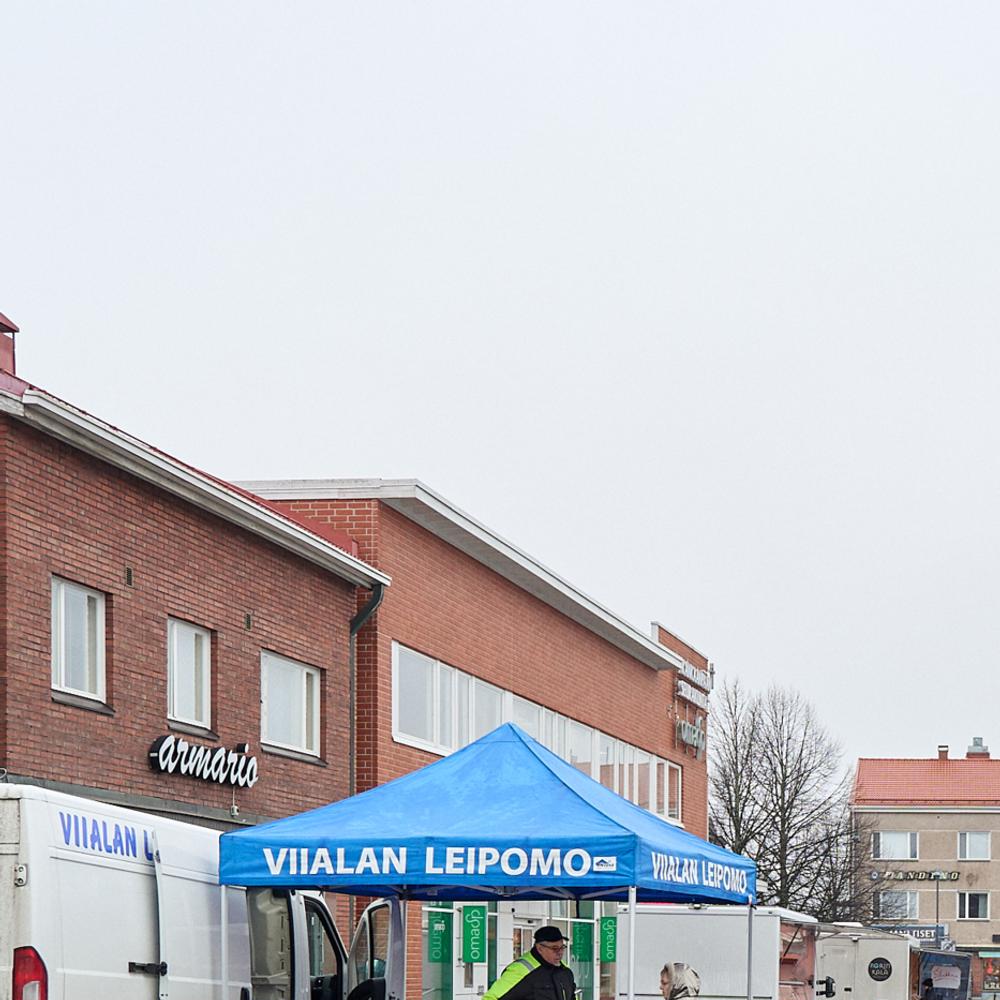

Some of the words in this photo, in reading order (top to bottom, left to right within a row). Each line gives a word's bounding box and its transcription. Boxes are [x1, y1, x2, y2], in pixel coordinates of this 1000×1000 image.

[159, 735, 259, 788] armario
[59, 811, 137, 858] VIIALAN
[262, 846, 407, 876] VIIALAN
[425, 846, 591, 878] LEIPOMO
[652, 851, 699, 885] VIIALAN
[701, 860, 748, 894] LEIPOMO
